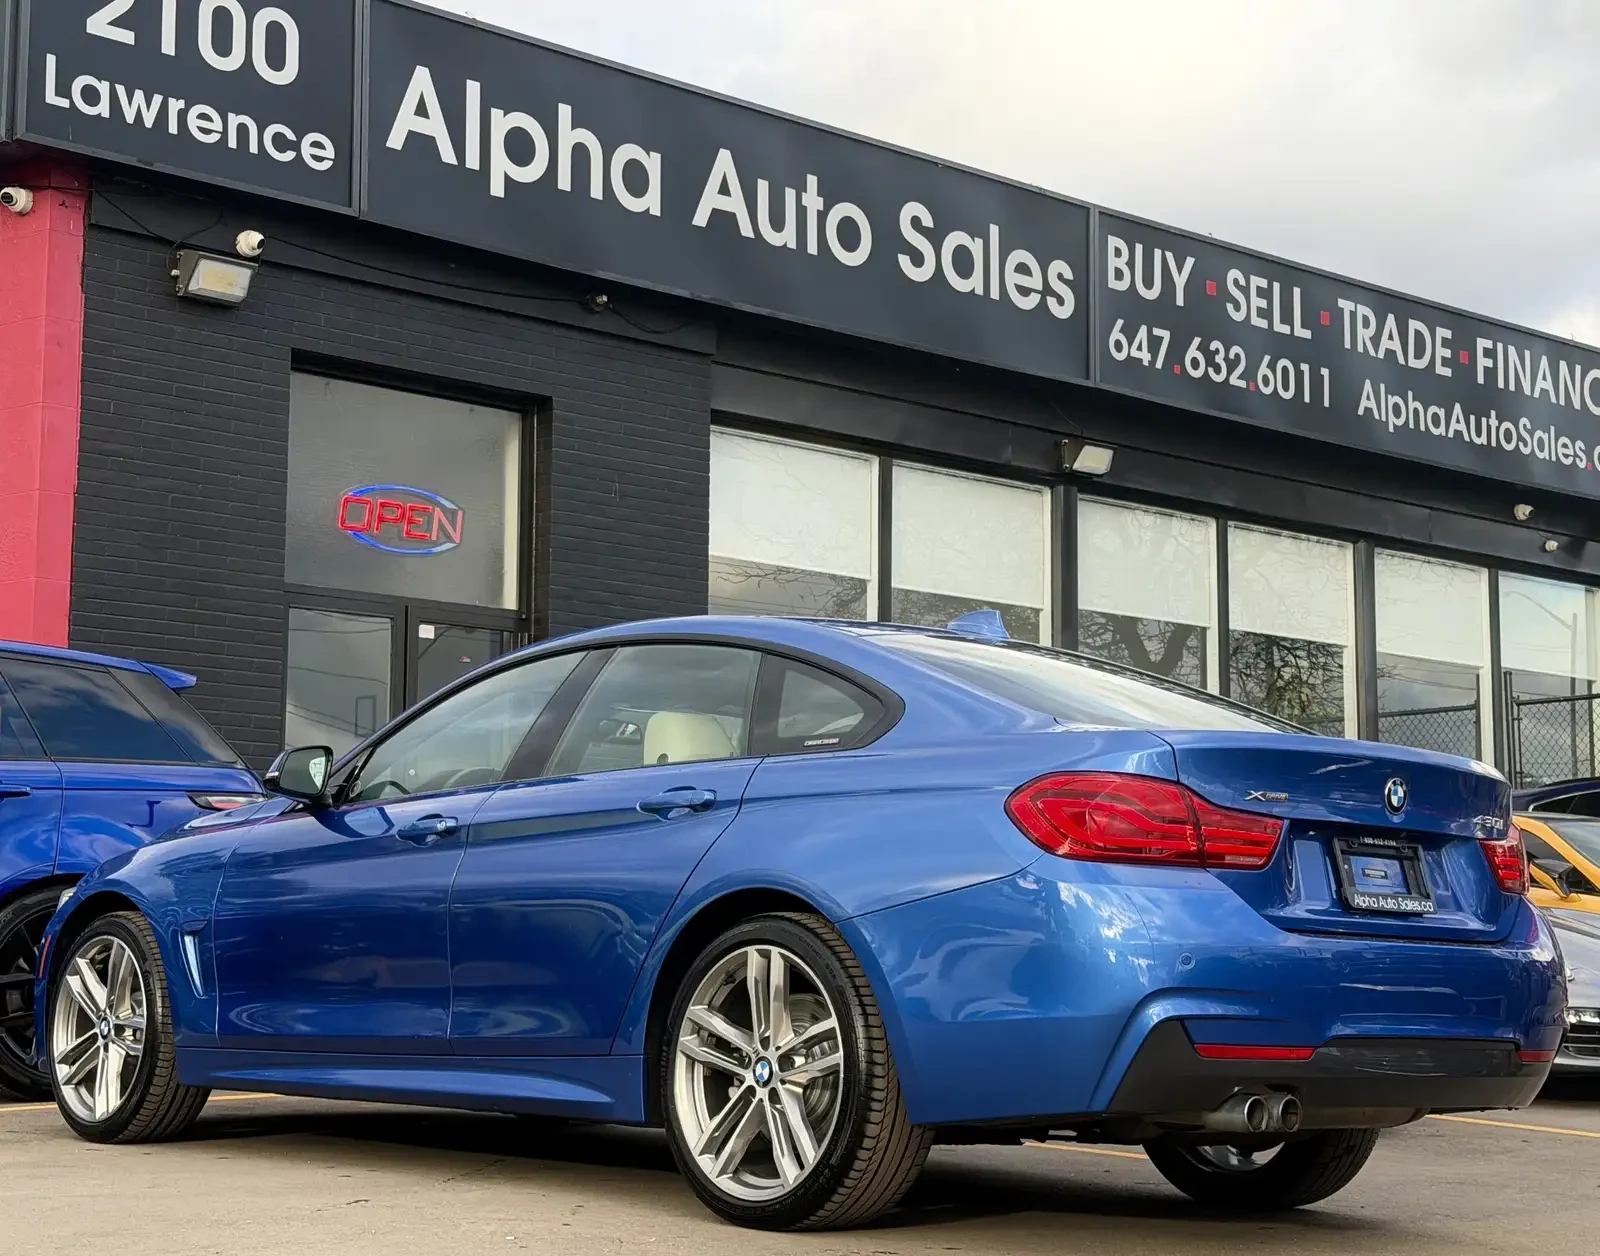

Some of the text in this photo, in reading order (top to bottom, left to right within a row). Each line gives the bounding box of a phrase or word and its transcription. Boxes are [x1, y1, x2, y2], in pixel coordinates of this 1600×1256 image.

[45, 53, 335, 171] Lawrence
[385, 65, 1076, 320] Alpha Auto Sales
[1107, 235, 1195, 307] BUY
[1226, 268, 1312, 340] SELL
[1337, 297, 1453, 377] TRADE
[1108, 318, 1331, 408] 647.632.6011
[338, 494, 463, 544] OPEN
[1354, 893, 1434, 912] Alpha Auto Sales.ca
